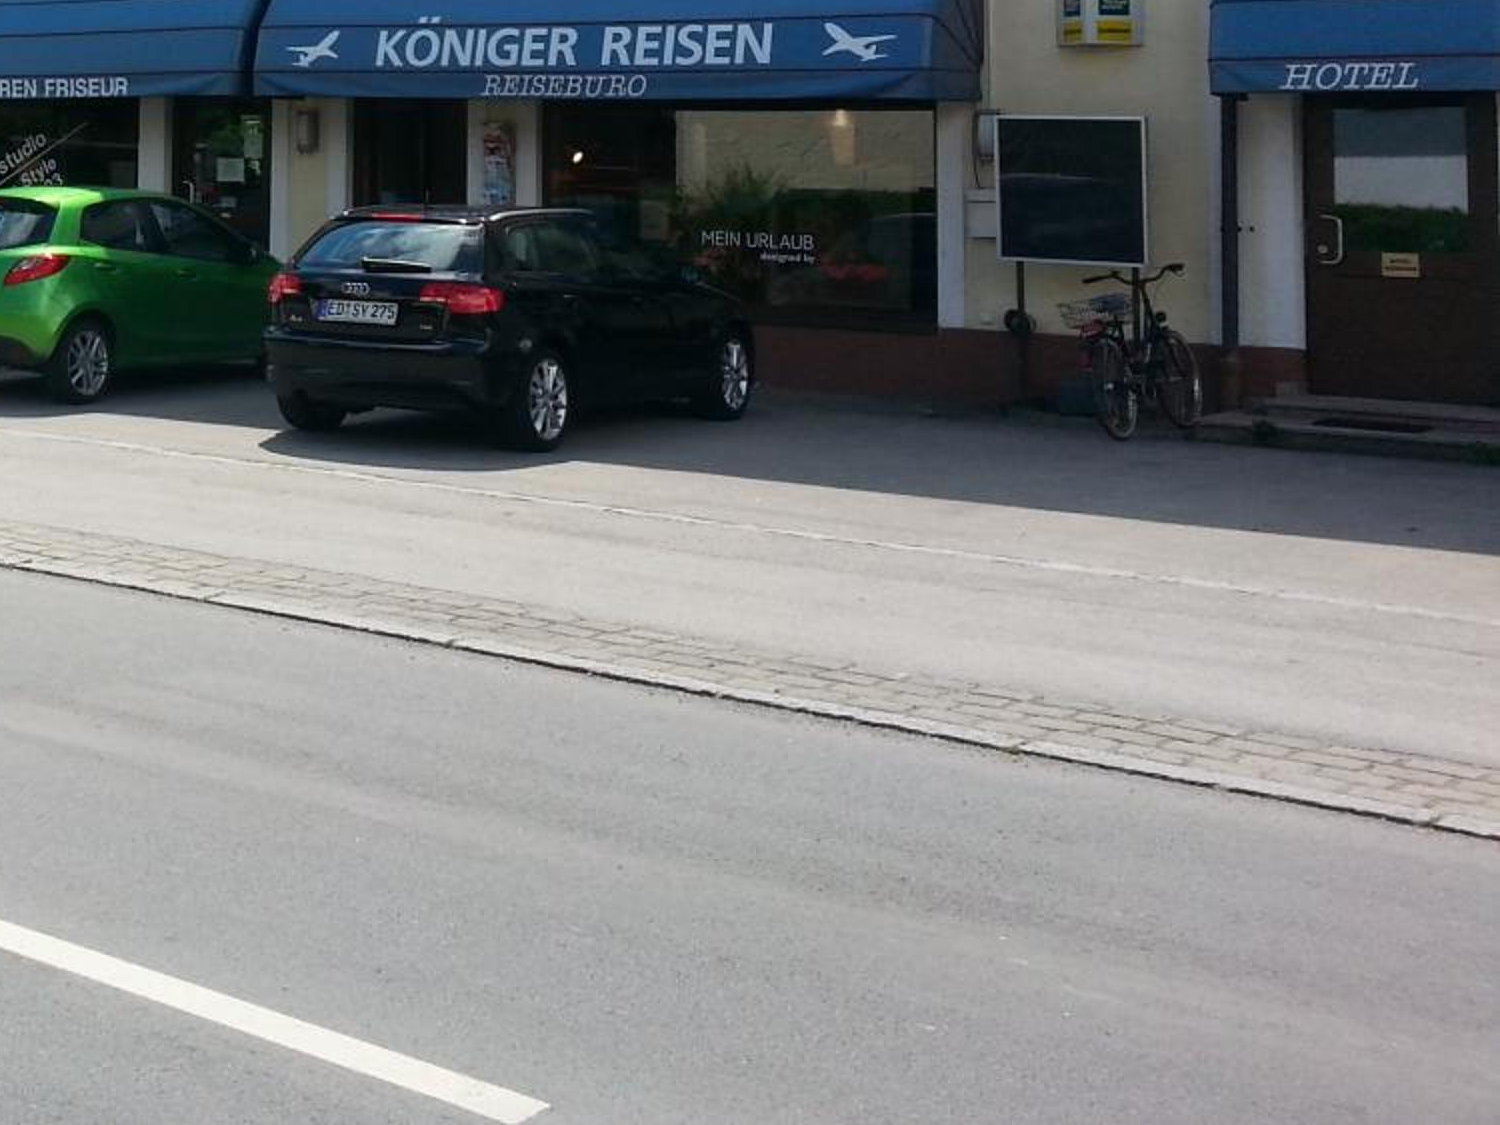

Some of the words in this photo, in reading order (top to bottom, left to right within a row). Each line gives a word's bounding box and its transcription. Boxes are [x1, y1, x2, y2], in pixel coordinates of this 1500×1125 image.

[375, 16, 580, 67] KÖNIGER
[601, 22, 773, 66] REISEN
[1278, 61, 1419, 90] HOTEL
[44, 77, 129, 97] FRISEUR
[701, 230, 741, 247] MEIN
[746, 232, 815, 250] URLAUB
[327, 302, 345, 316] ED
[371, 304, 396, 320] 275
